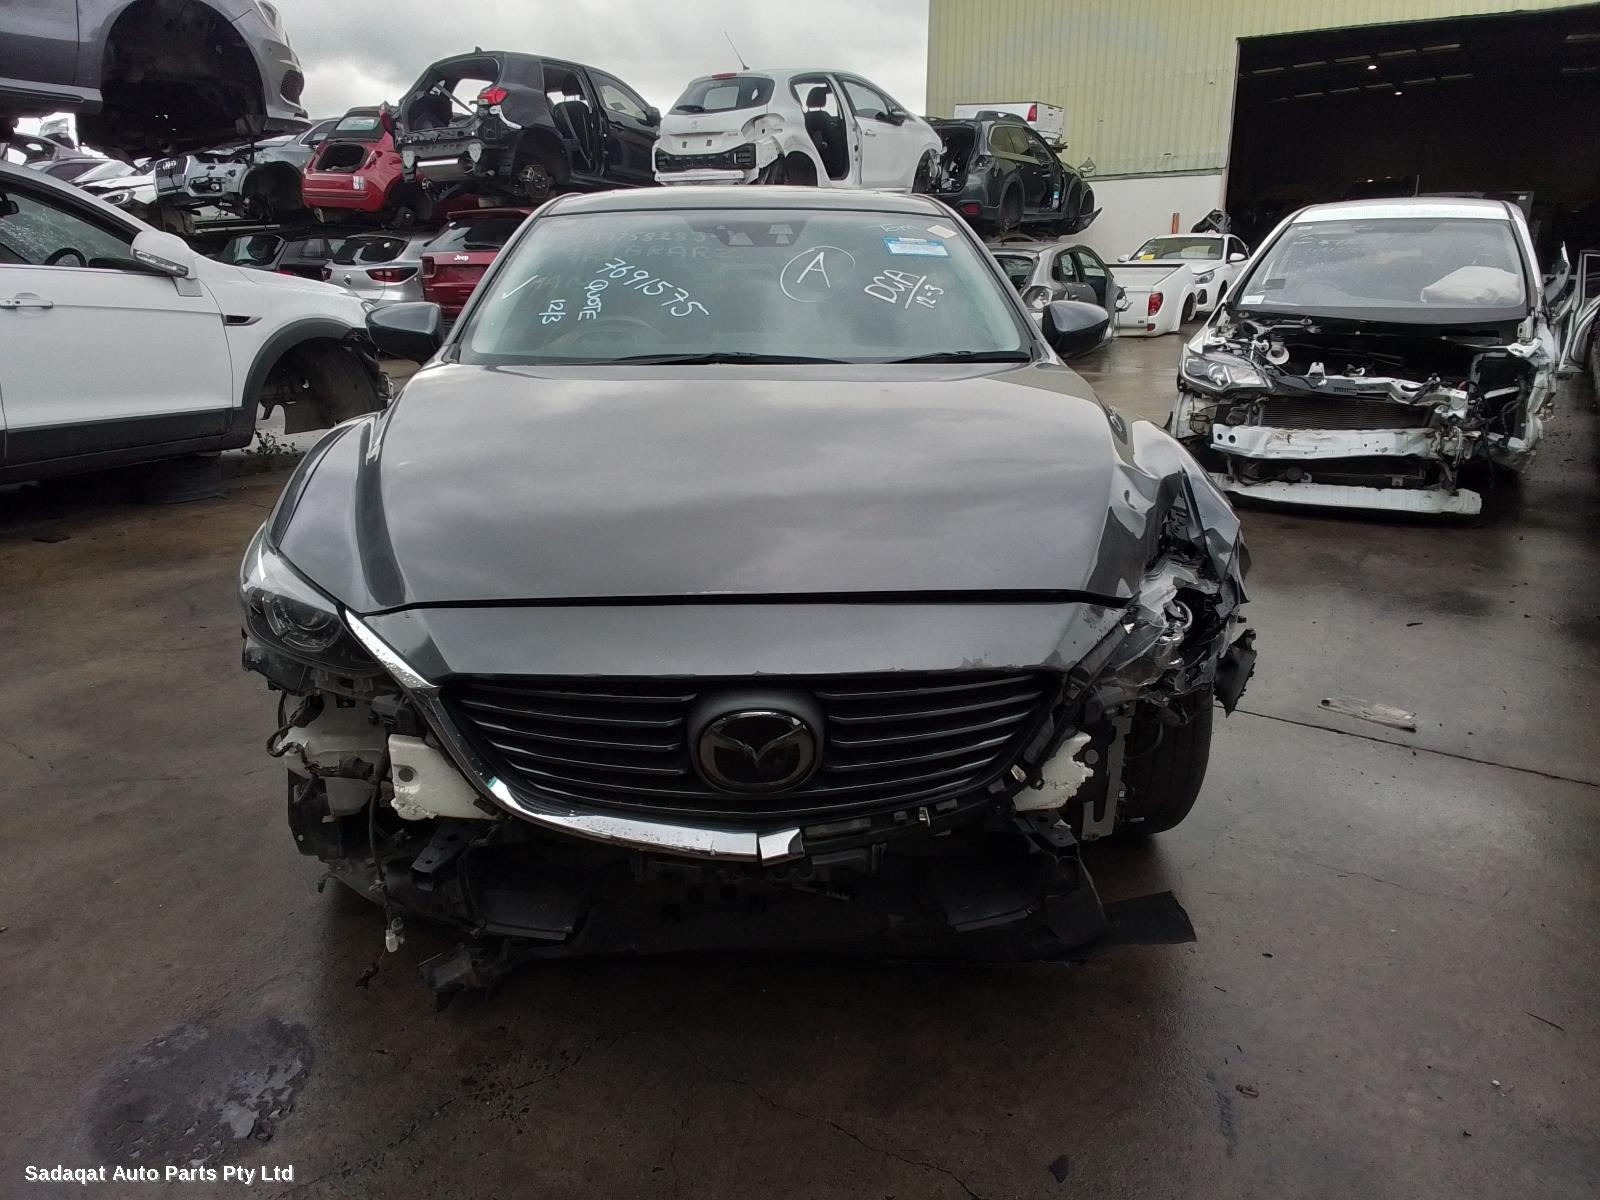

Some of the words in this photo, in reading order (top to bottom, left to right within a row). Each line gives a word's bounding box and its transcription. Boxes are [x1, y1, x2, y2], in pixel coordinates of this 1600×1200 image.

[454, 254, 469, 262] Jeep
[797, 251, 831, 288] A
[578, 279, 608, 321] QUOTE
[596, 257, 709, 317] 7691575
